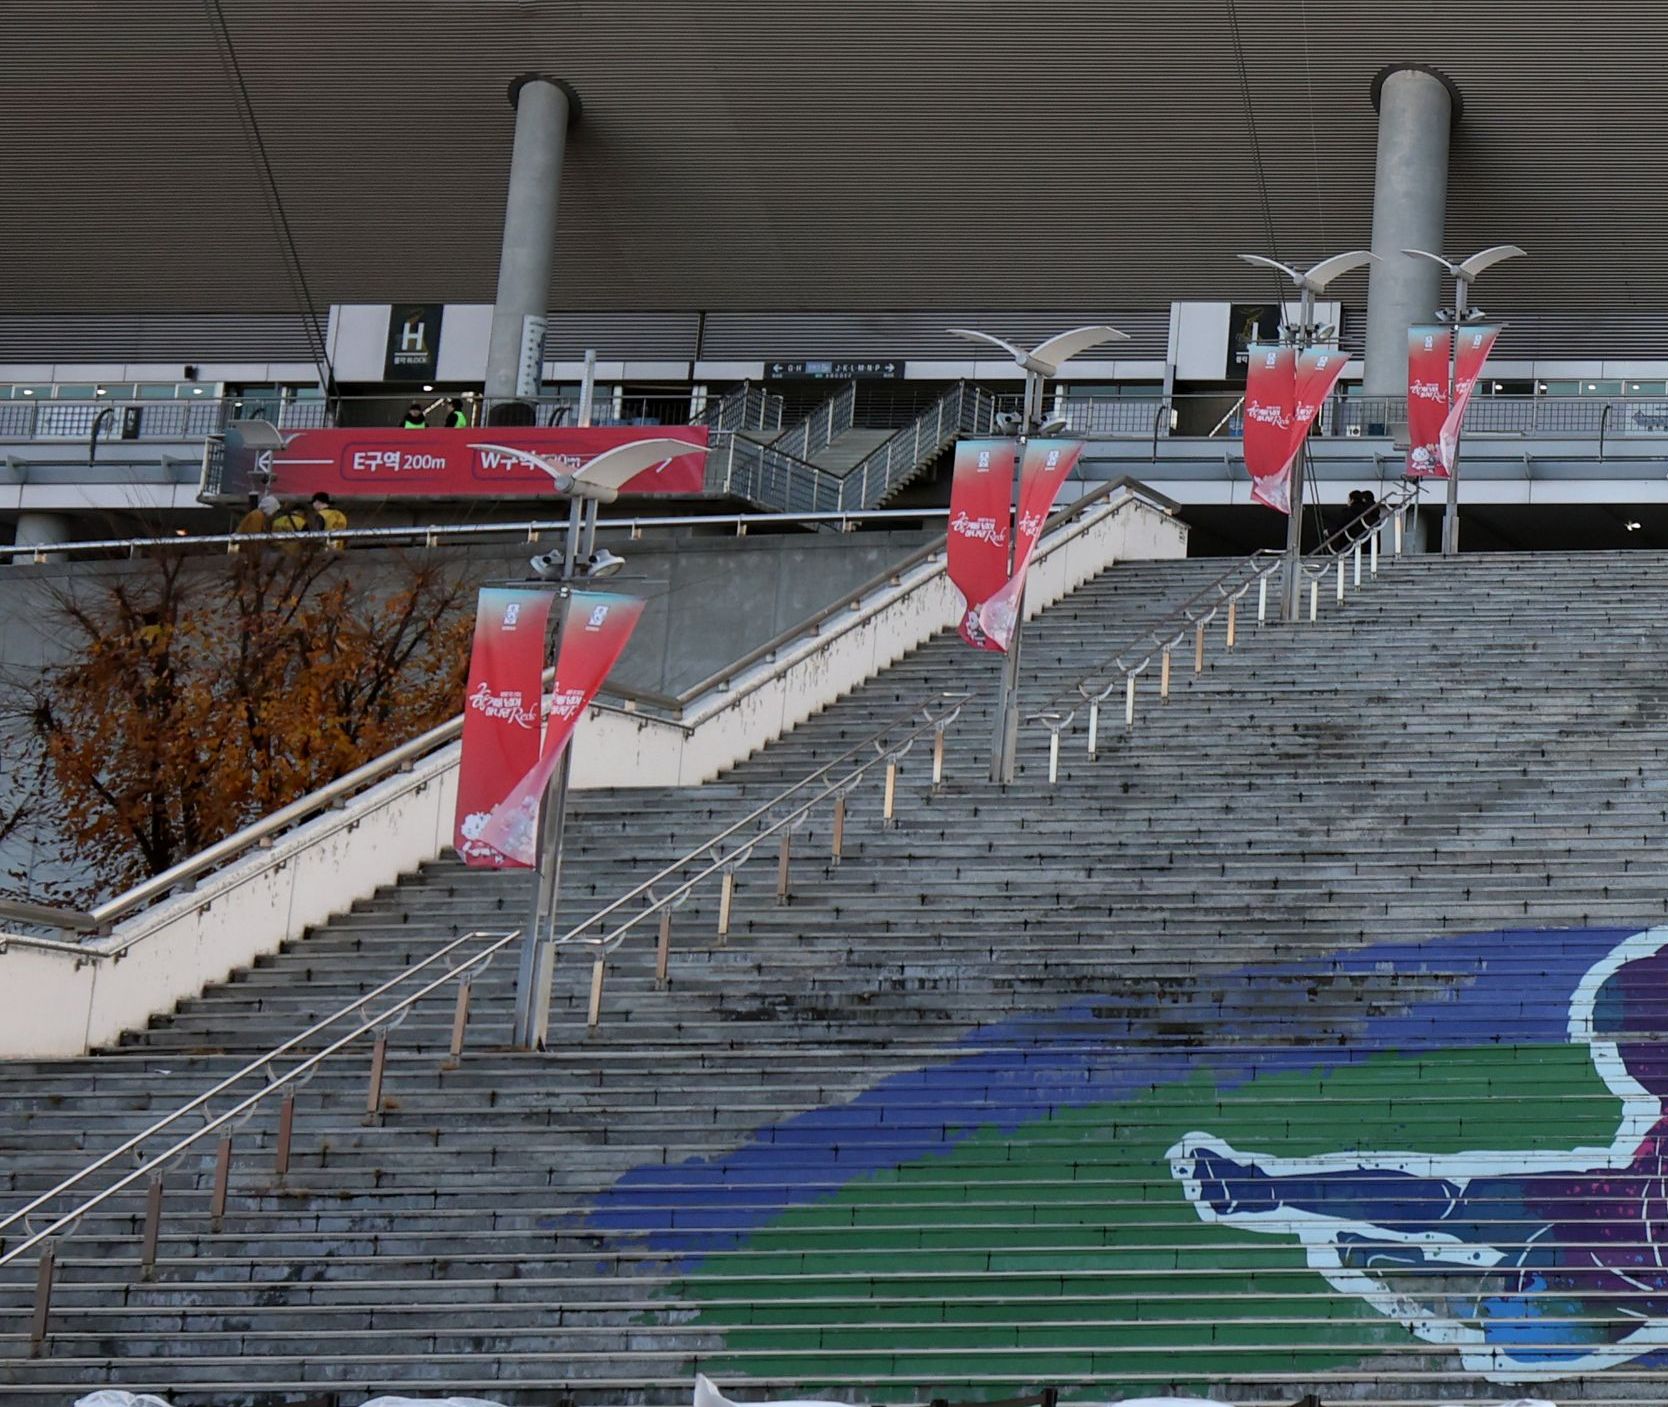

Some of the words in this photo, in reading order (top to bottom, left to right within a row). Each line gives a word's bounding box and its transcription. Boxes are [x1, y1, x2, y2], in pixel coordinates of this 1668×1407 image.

[401, 322, 425, 351] H
[353, 451, 400, 472] E구역
[403, 455, 446, 469] 200m
